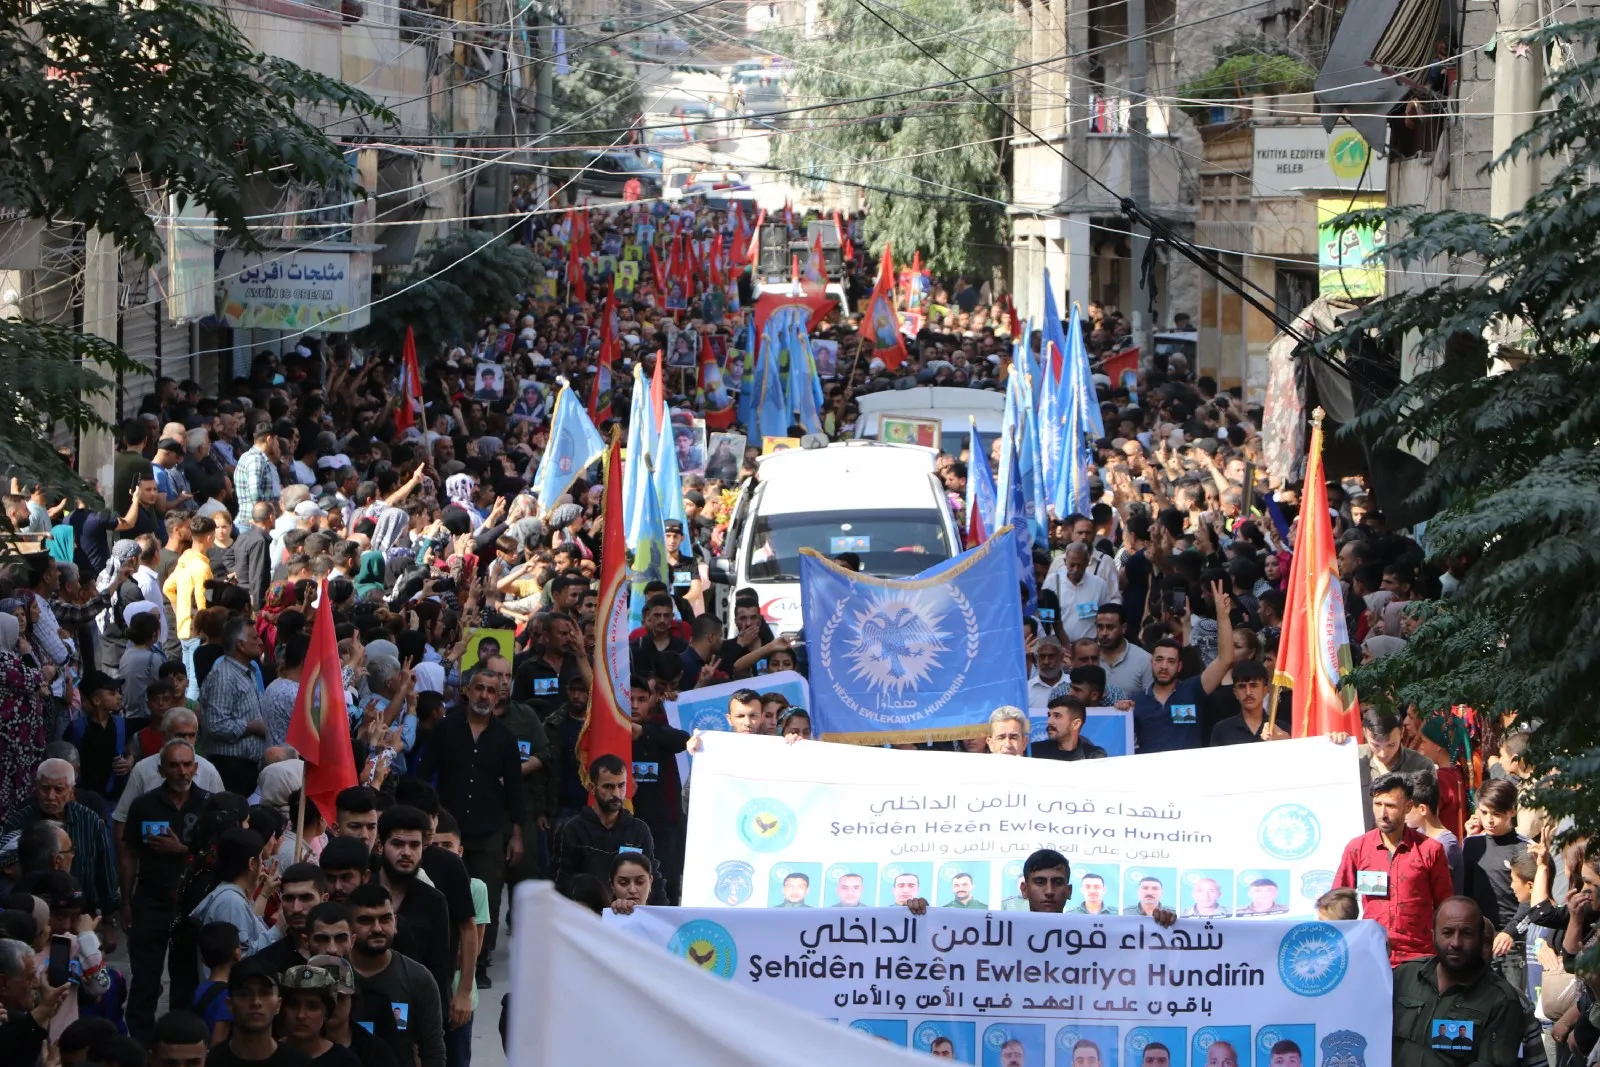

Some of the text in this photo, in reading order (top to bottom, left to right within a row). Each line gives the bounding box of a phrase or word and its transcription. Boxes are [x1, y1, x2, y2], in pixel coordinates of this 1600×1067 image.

[1276, 163, 1304, 174] HELEB
[287, 262, 344, 286] مثلجات
[293, 288, 333, 300] CREAM
[858, 707, 924, 725] EWLEKARIYA
[869, 790, 1182, 820] شهداء قوى الأمن الداخلي
[830, 819, 1213, 843] Şehîdên Hêzên Ewlekariya Hundirîn
[800, 912, 1224, 956] شهداء قوى الأمن الداخلي
[749, 954, 865, 982] Şehîdên
[875, 955, 965, 981] Hêzên
[976, 958, 1136, 990] Ewlekariya
[1147, 962, 1265, 987] Hundirîn
[834, 984, 1212, 1017] باقون على العهد في الأمن والأمان
